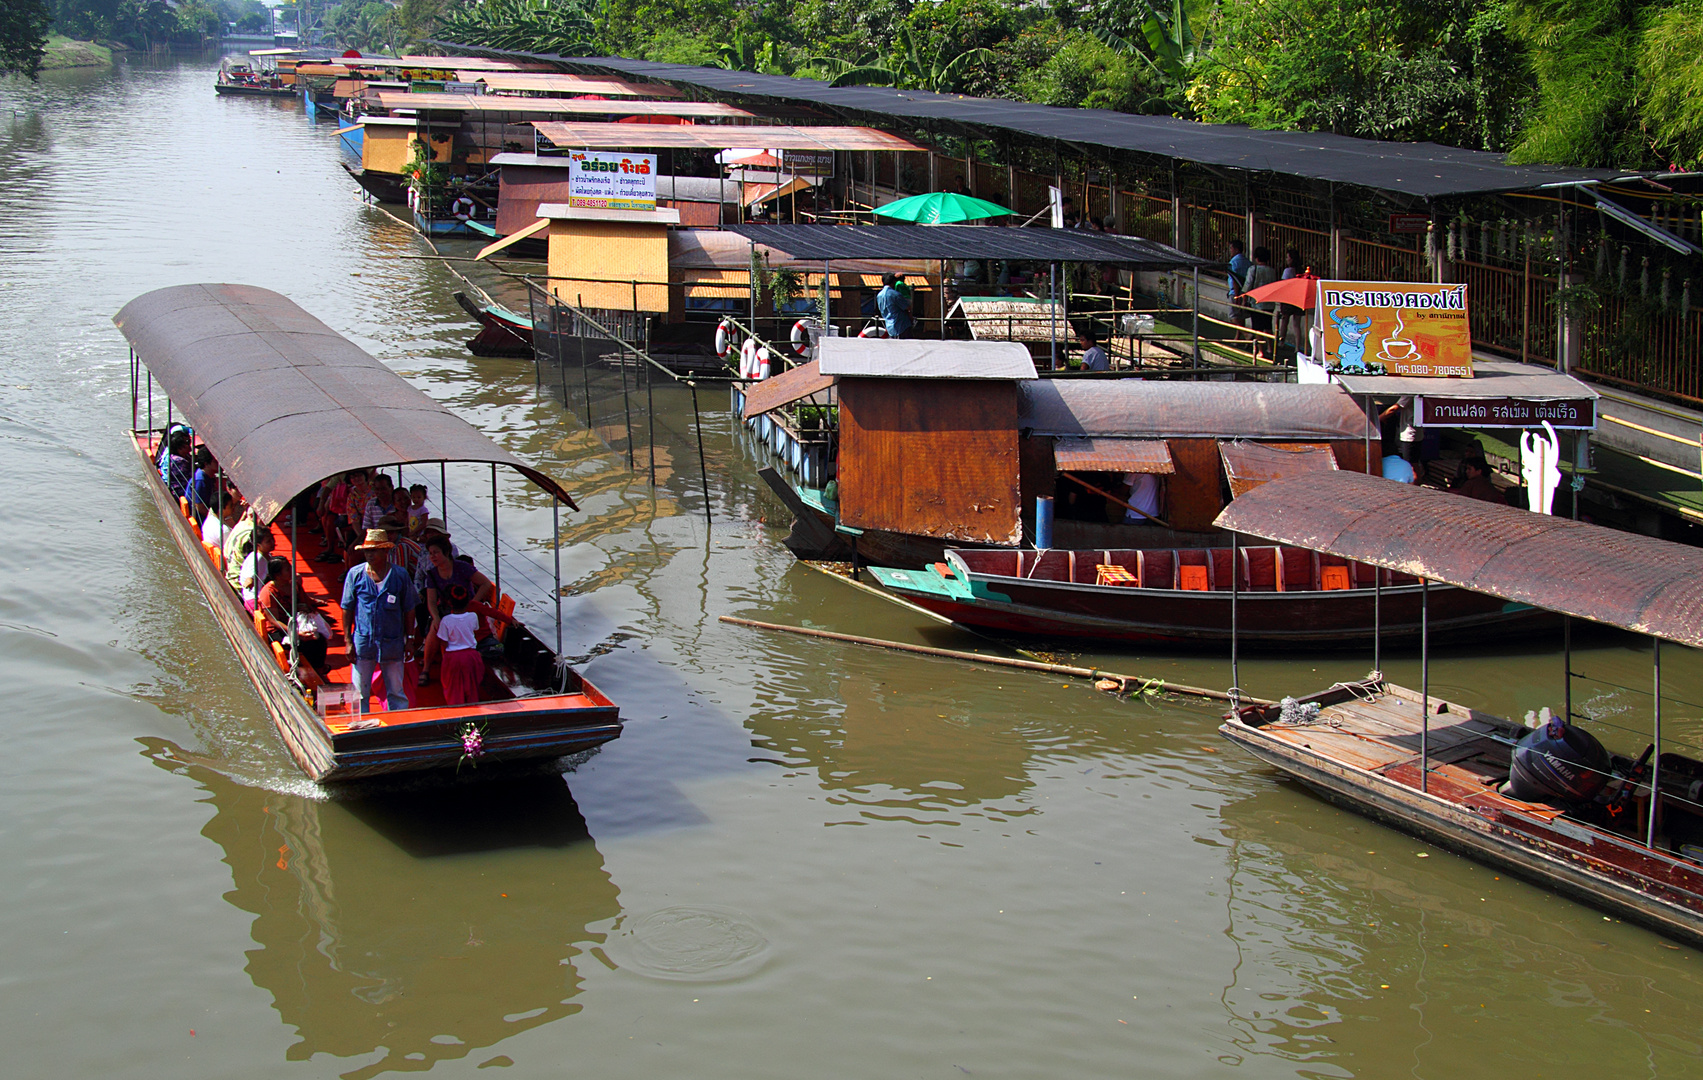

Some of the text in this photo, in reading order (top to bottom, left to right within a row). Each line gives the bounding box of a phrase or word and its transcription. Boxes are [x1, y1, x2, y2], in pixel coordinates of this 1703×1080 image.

[1325, 286, 1465, 310] กระแชงคอฟฟี่
[1416, 312, 1426, 320] by
[1435, 402, 1577, 419] กาแฟสด รสเข้ม เต็มเรือ
[1543, 750, 1576, 781] YAMAHA
